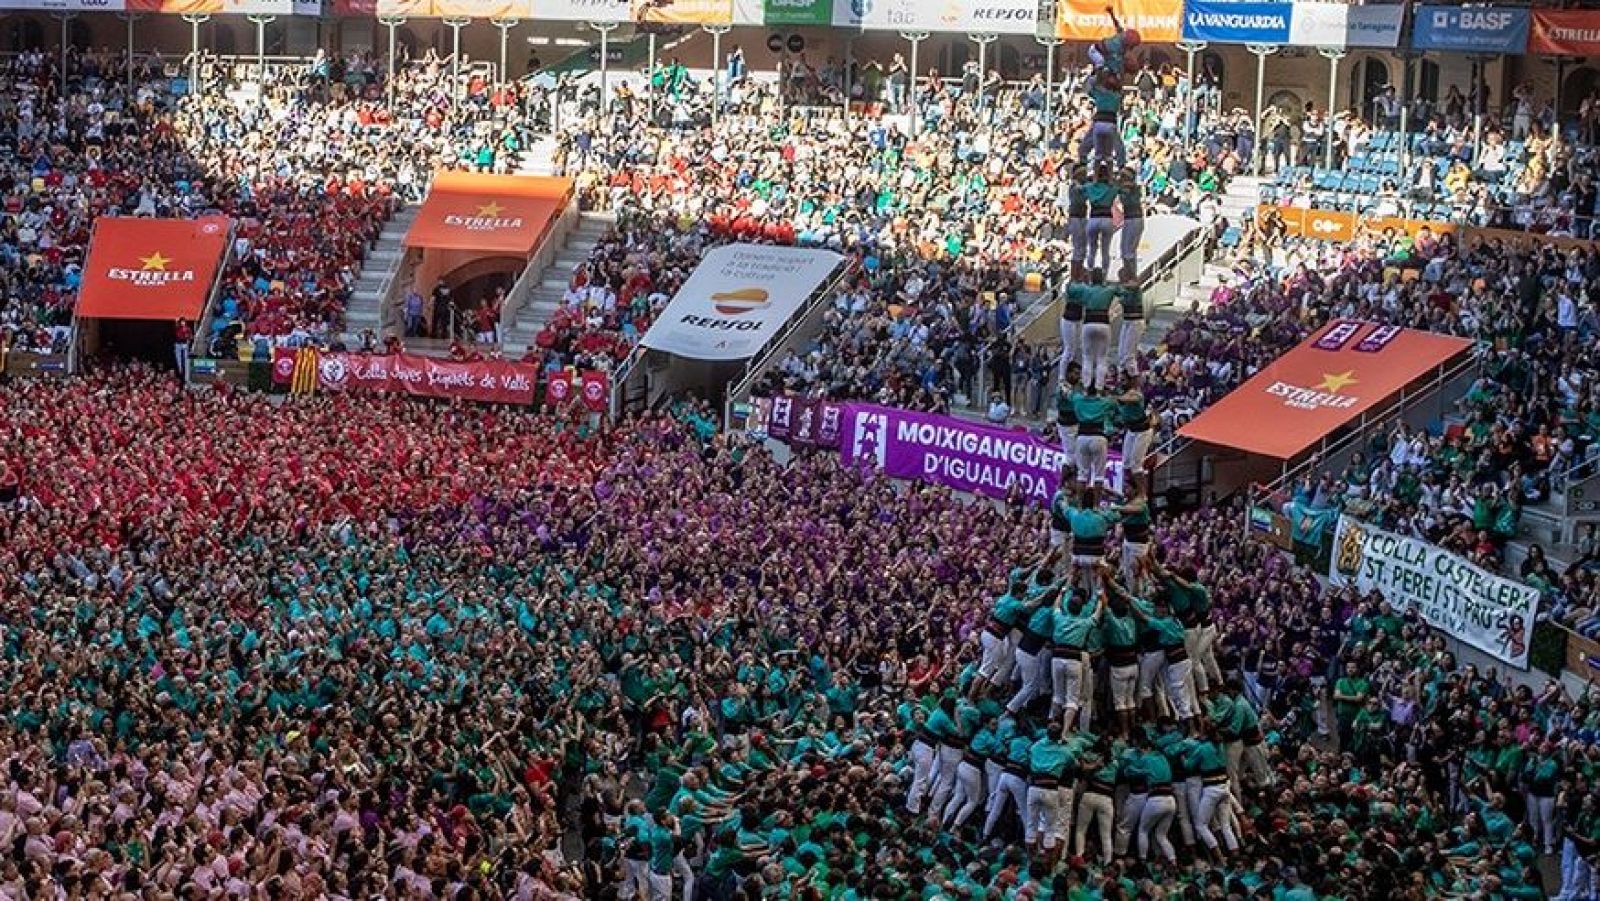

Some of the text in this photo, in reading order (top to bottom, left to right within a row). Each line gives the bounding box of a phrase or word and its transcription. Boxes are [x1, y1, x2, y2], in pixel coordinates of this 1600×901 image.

[973, 8, 1034, 20] REPSOL
[1459, 12, 1512, 30] BASF
[444, 215, 523, 228] ESTRELLA
[107, 268, 194, 282] ESTRELLA
[681, 314, 763, 331] REPSOL
[354, 361, 388, 380] Colla
[389, 363, 423, 382] Joves
[480, 373, 497, 389] de
[501, 373, 531, 391] Valls
[1264, 381, 1360, 408] ESTRELLA
[898, 420, 1069, 473] MOIXIGANGUER
[924, 453, 1049, 499] D'IGUALADA
[1366, 556, 1387, 585] ST.
[1392, 565, 1433, 600] PERE
[1371, 534, 1530, 611] COLLA CASTELLERA
